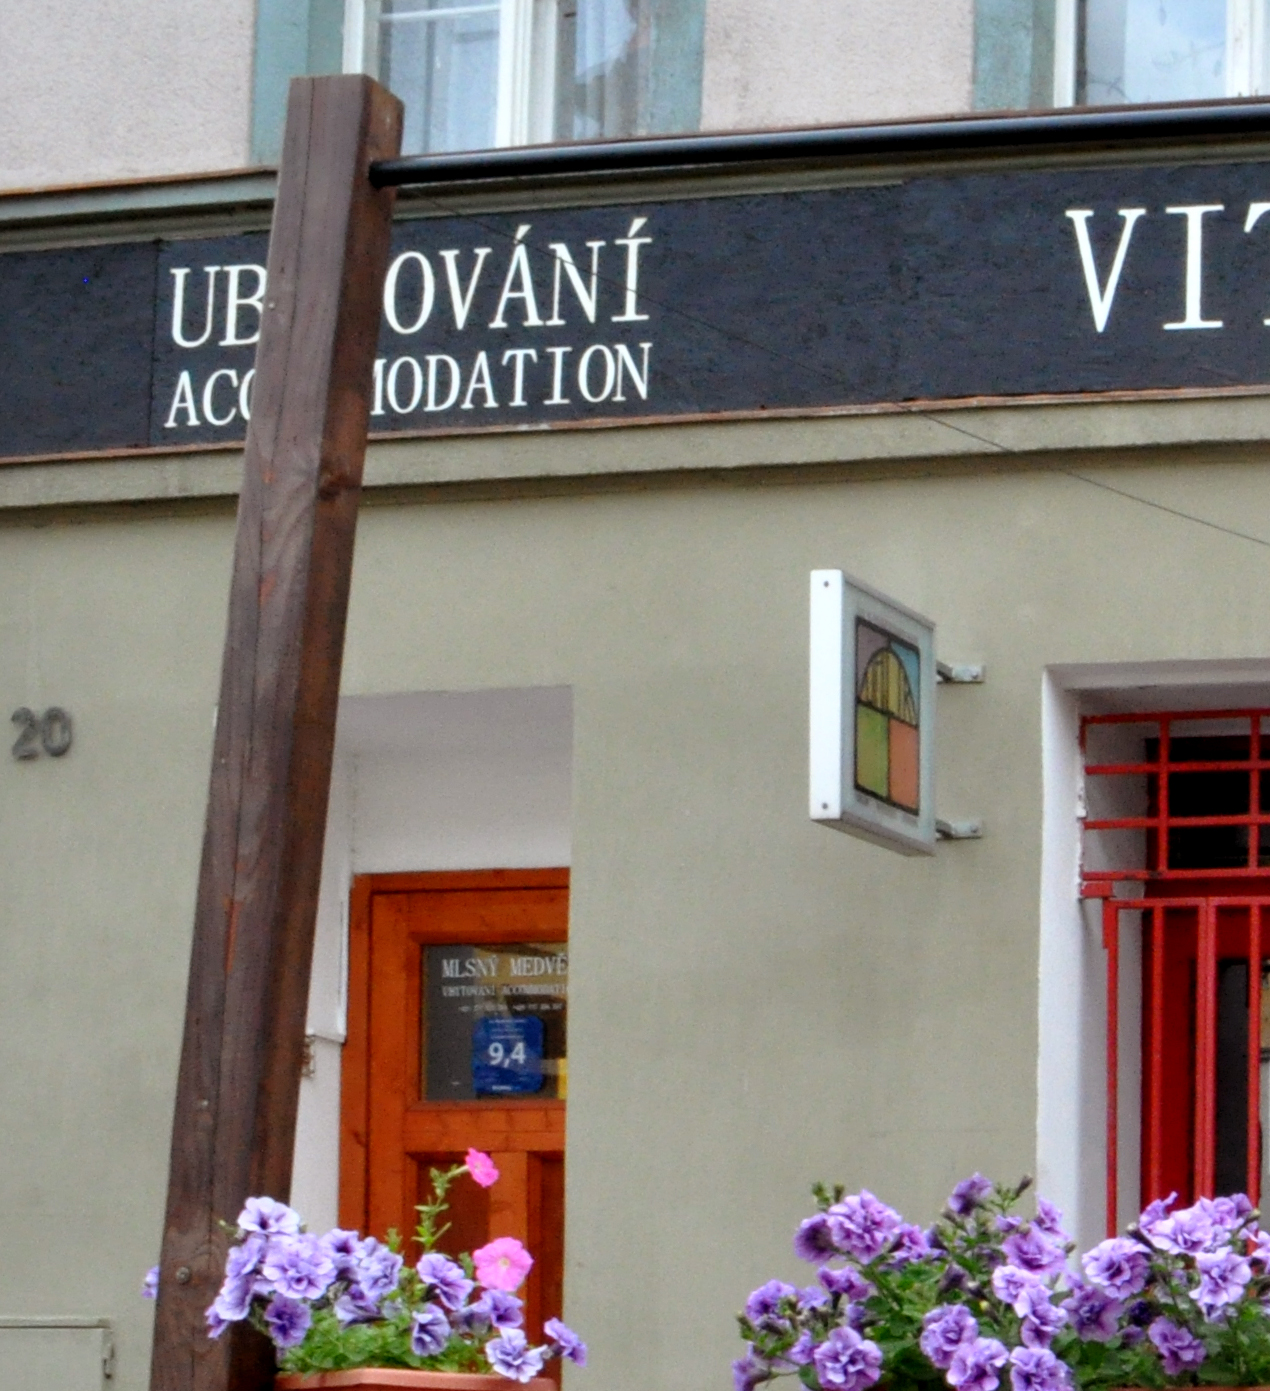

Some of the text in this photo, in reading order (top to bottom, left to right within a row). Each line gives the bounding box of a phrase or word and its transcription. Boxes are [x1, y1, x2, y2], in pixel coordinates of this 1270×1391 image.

[170, 217, 653, 348] UBOVÁNÍ
[11, 707, 73, 761] 20
[442, 955, 499, 978] MLSNÝ
[488, 1042, 526, 1068] 9,4
